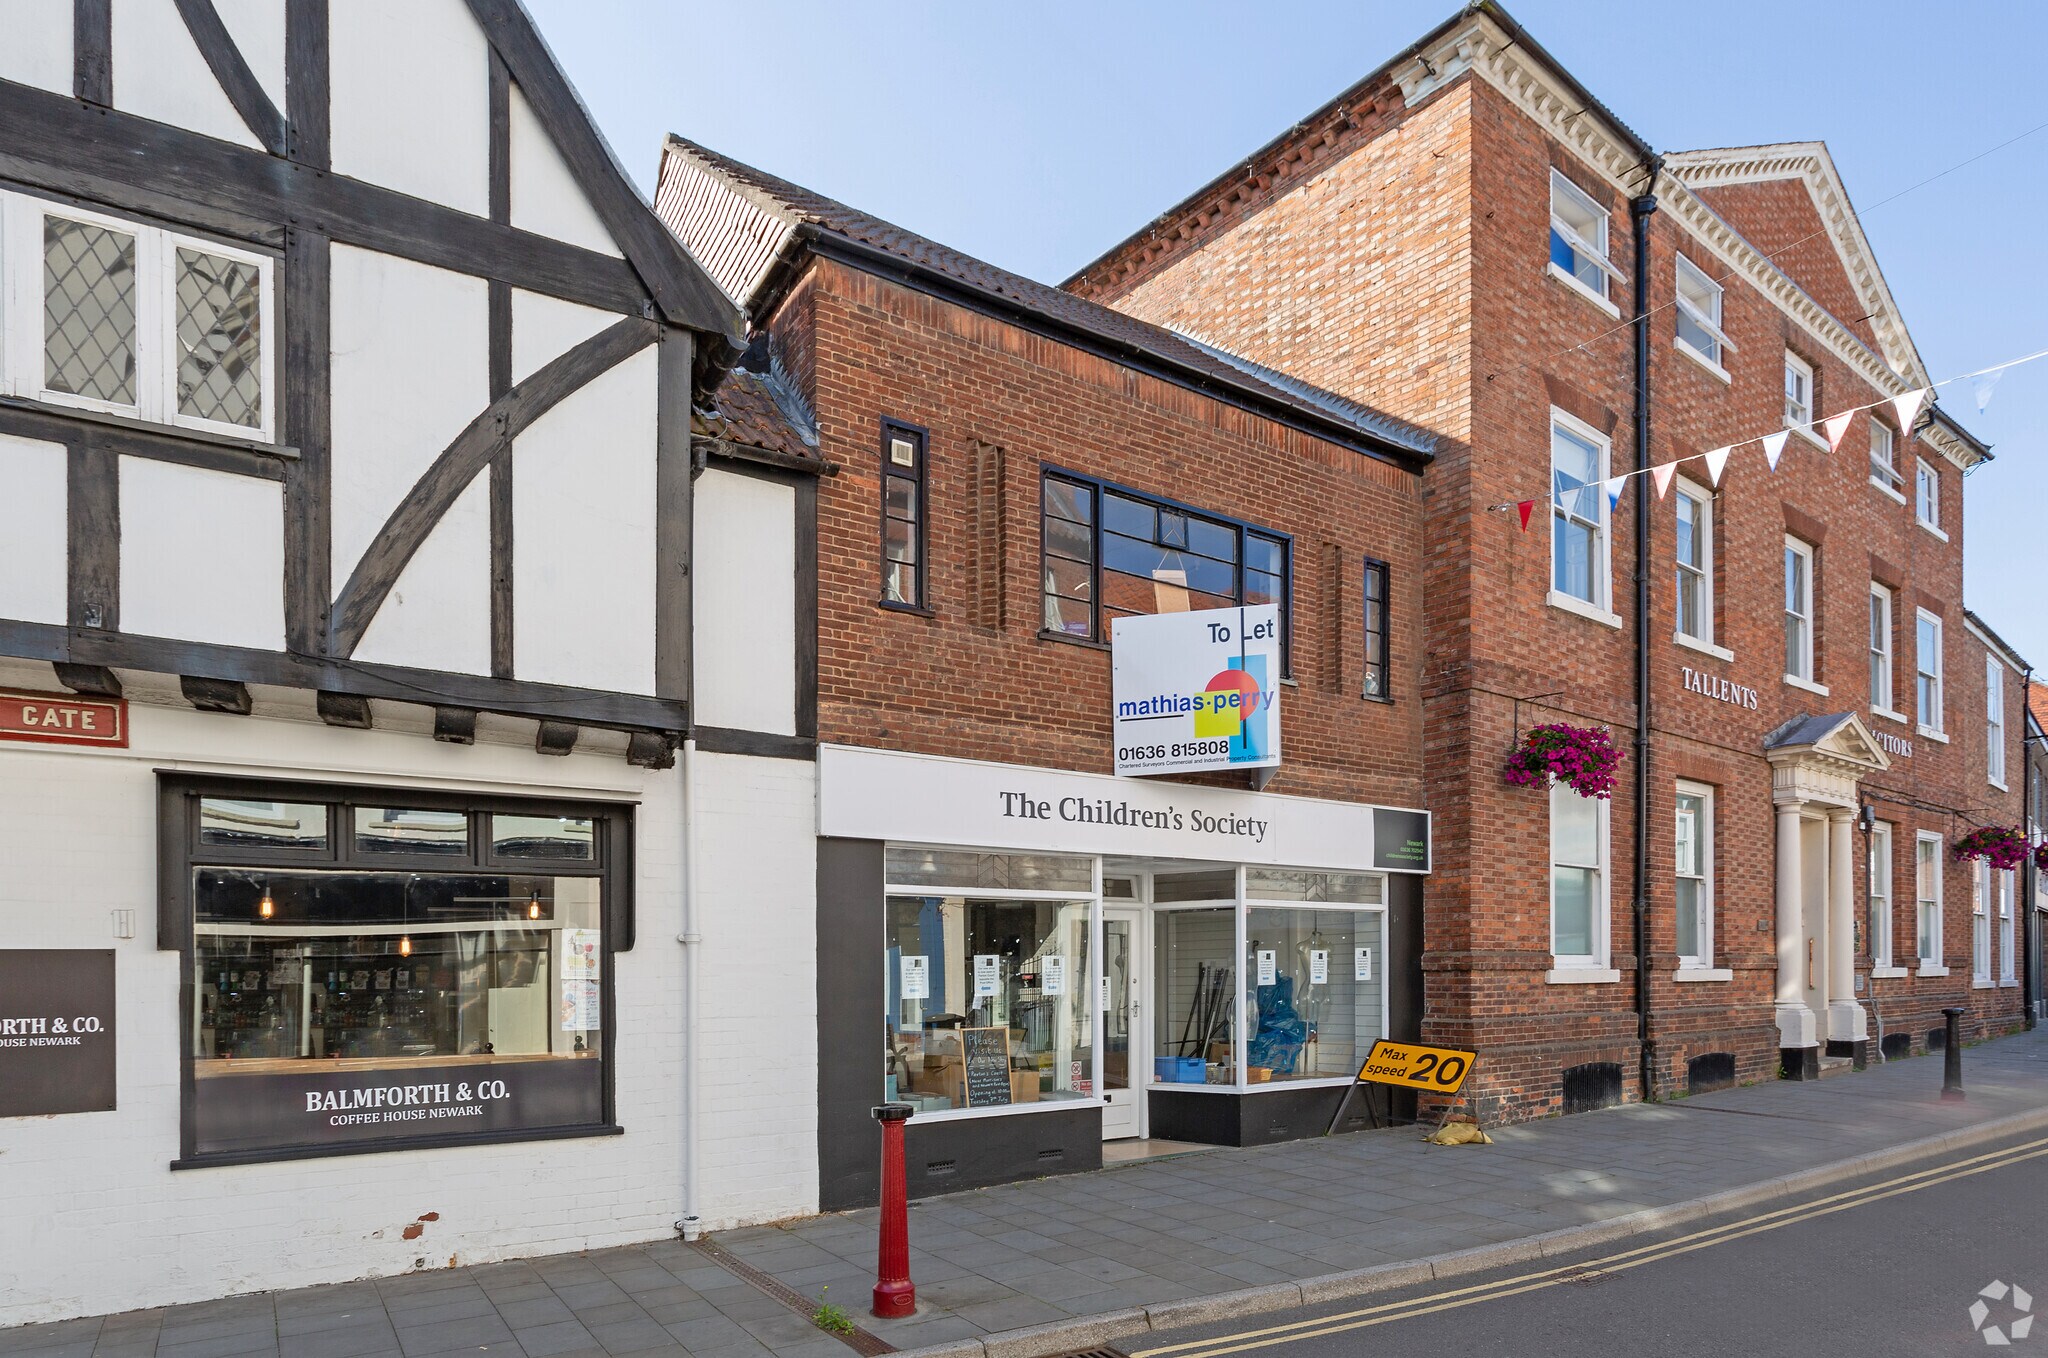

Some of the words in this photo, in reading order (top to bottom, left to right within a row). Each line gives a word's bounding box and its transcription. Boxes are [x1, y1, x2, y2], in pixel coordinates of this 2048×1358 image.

[1207, 623, 1231, 643] To
[1241, 619, 1274, 641] Let
[1681, 666, 1758, 710] TALLENTS
[22, 706, 96, 730] GATE
[1119, 744, 1166, 761] 01636
[1171, 740, 1229, 757] 815808
[1118, 761, 1142, 769] Chartered
[1166, 758, 1193, 766] Commercial
[1226, 755, 1247, 763] Property
[1000, 791, 1051, 820] The
[1058, 797, 1183, 831] Children's
[1190, 809, 1268, 843] Society
[0, 1018, 47, 1035] RTH
[51, 1017, 69, 1034] &
[73, 1016, 105, 1033] CO.
[29, 1036, 81, 1047] NEWARK
[968, 1034, 998, 1047] Please
[1366, 1064, 1408, 1077] speed
[1379, 1048, 1408, 1061] Max
[1407, 1053, 1466, 1085] 20
[305, 1084, 450, 1112] BALMFORTH
[455, 1082, 473, 1101] &
[477, 1080, 511, 1100] CO.
[330, 1112, 380, 1126] COFFEE
[383, 1109, 426, 1122] HOUSE
[429, 1105, 483, 1119] NEWARK
